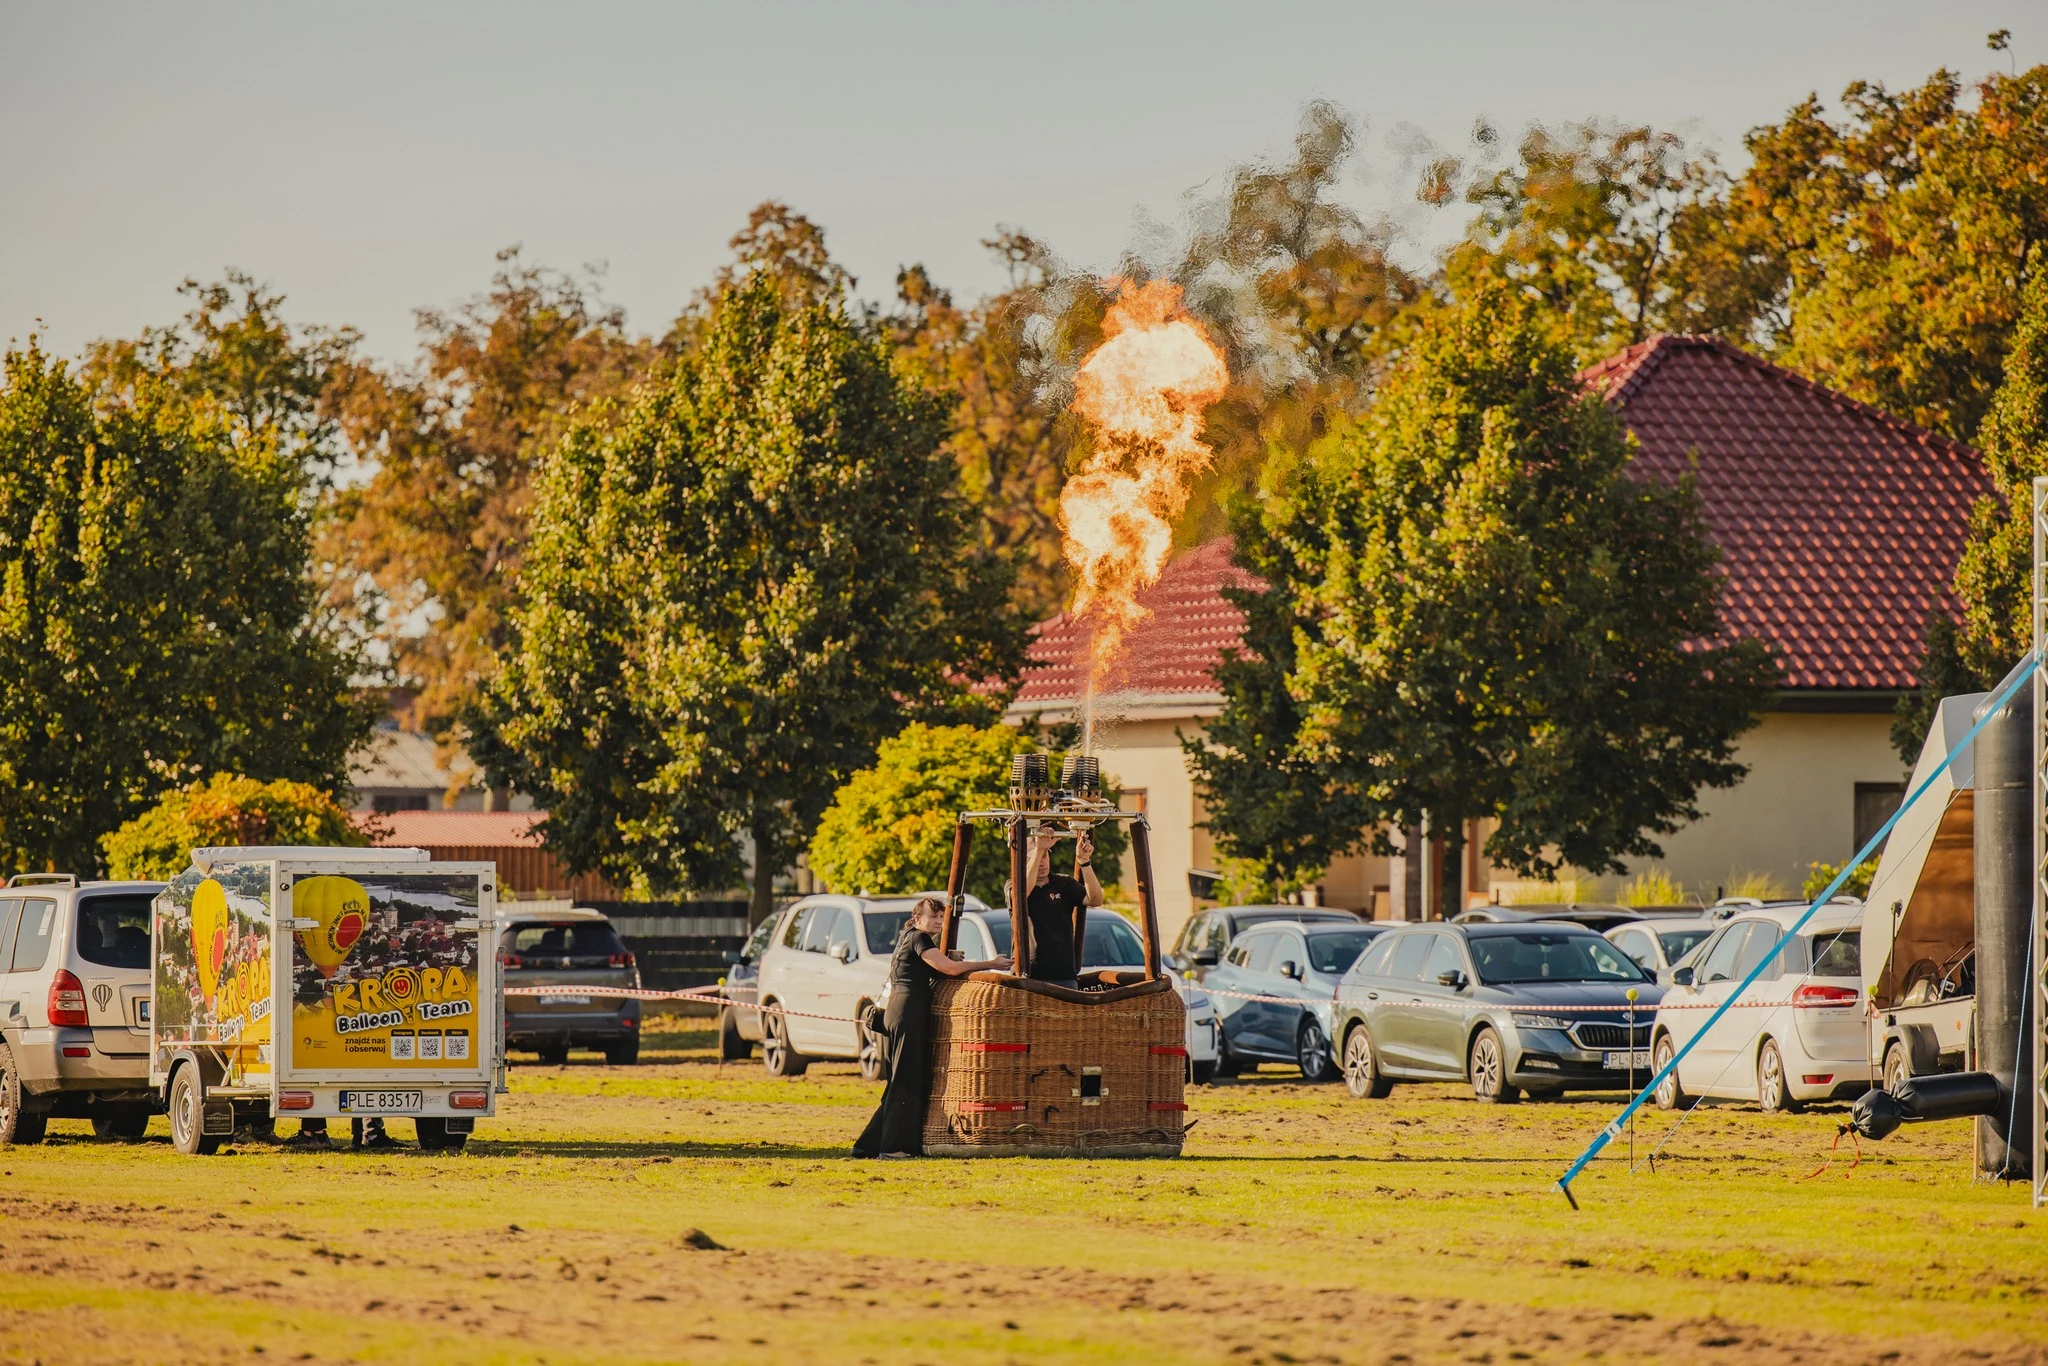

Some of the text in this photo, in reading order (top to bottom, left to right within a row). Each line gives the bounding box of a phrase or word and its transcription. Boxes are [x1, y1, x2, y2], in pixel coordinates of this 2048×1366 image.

[338, 1001, 471, 1032] Balloon Team
[345, 1037, 370, 1046] znajdź
[349, 1045, 386, 1054] obserwuj
[348, 1093, 375, 1107] PLE
[379, 1093, 420, 1107] 83517
